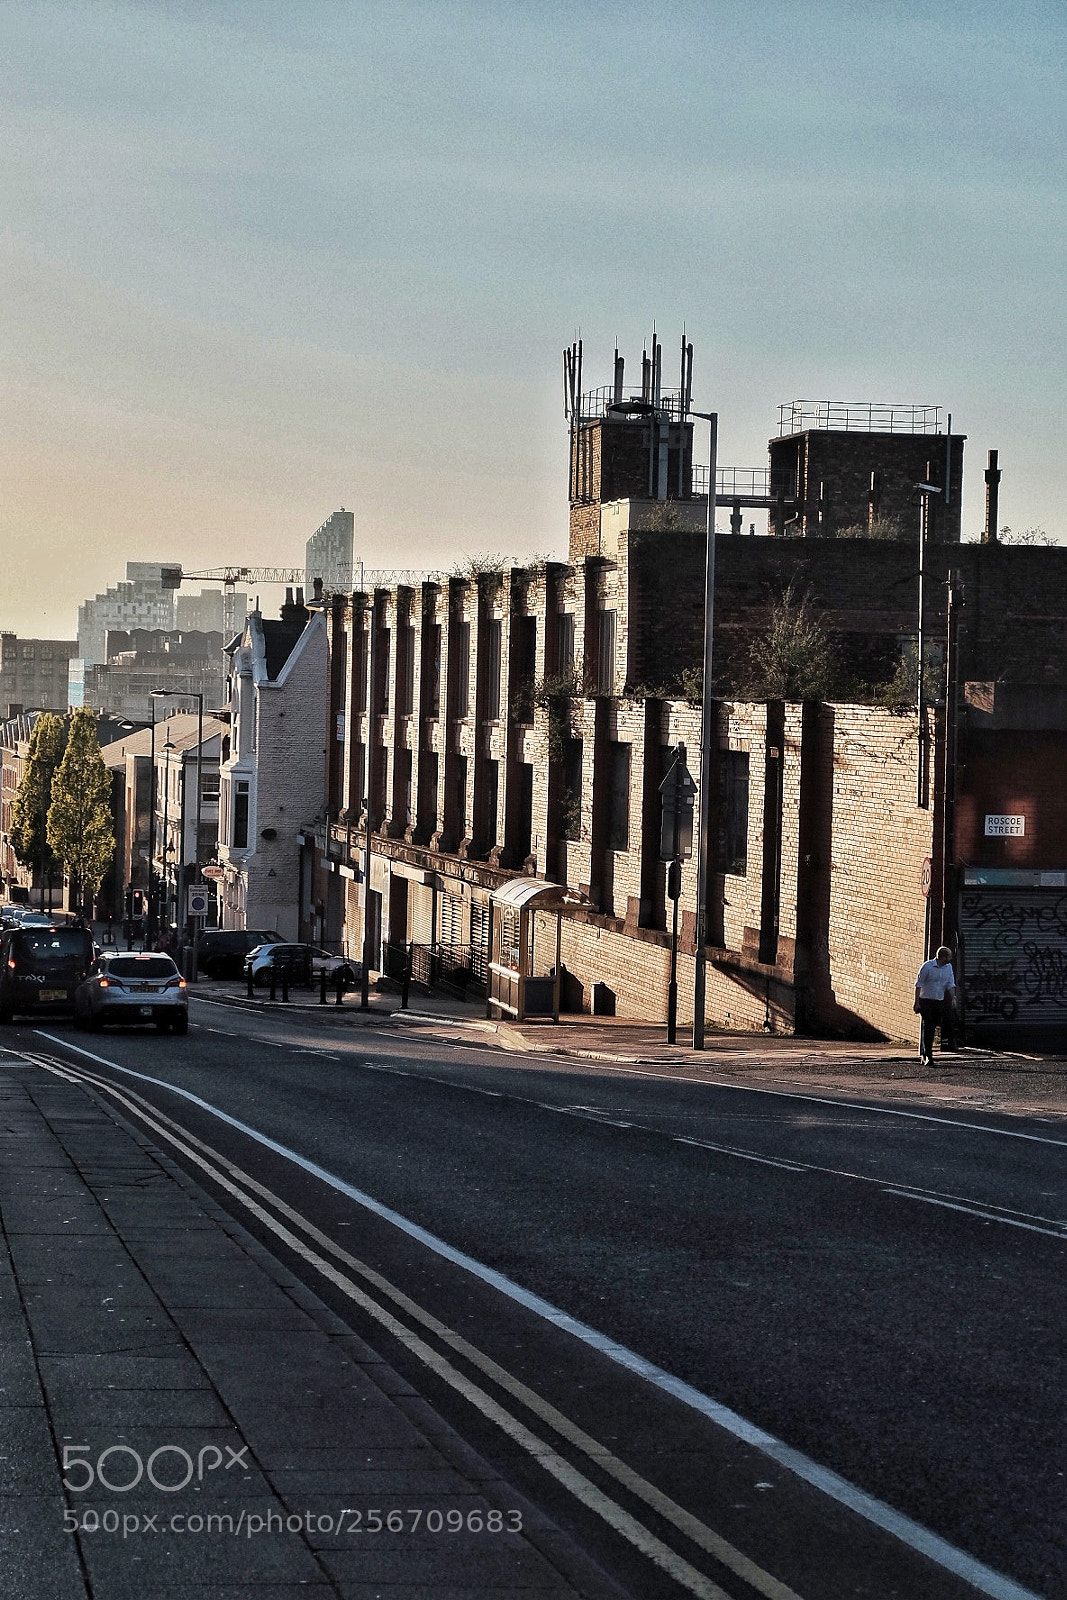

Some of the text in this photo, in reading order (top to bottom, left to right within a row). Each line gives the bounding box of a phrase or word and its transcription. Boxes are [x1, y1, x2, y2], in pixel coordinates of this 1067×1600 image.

[988, 817, 1021, 825] ROSCOE
[988, 826, 1020, 834] STREET
[923, 869, 929, 885] 20
[16, 974, 46, 983] TAXI
